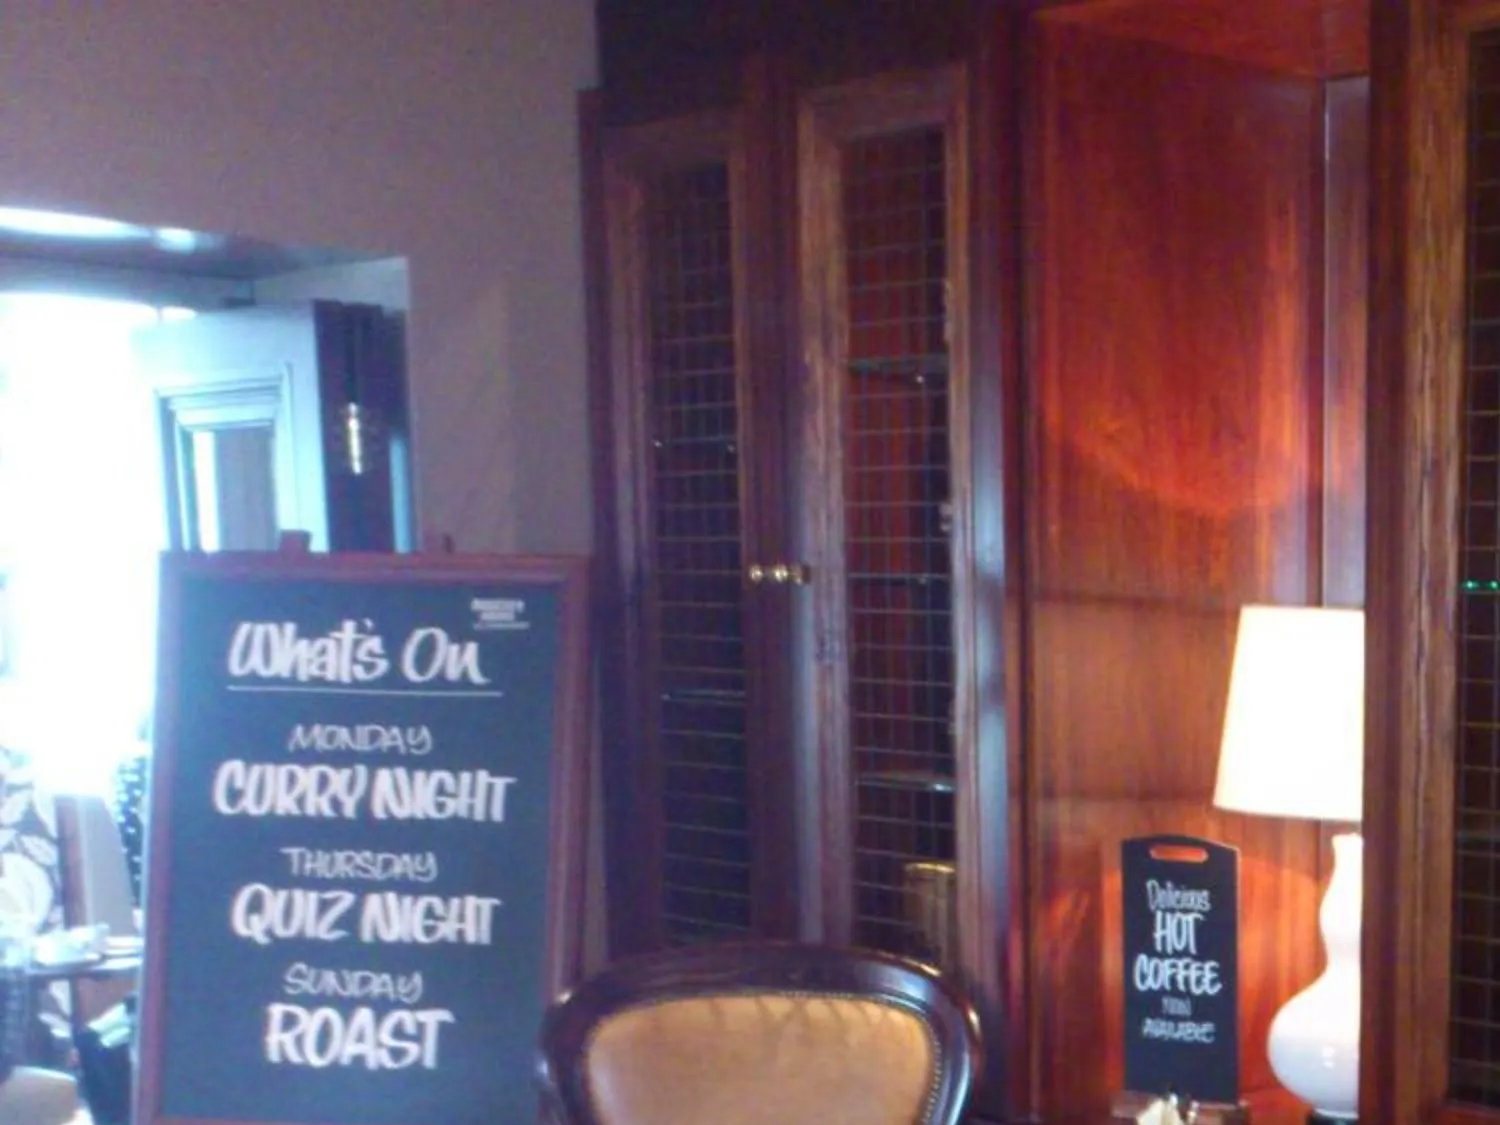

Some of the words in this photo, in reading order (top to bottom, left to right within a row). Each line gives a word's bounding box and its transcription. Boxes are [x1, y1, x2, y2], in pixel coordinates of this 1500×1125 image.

[229, 621, 388, 682] What's
[400, 627, 491, 685] On
[287, 724, 433, 754] MONDAY
[213, 761, 367, 820] CURRY
[372, 768, 517, 822] NIGHT
[280, 847, 437, 882] THURSDAY
[230, 884, 356, 945] QUIZ
[359, 893, 502, 945] NIGHT
[1154, 911, 1205, 955] HOT
[284, 963, 422, 1001] SUNDAY
[1133, 954, 1223, 995] COFFEE
[267, 1004, 455, 1069] ROAST
